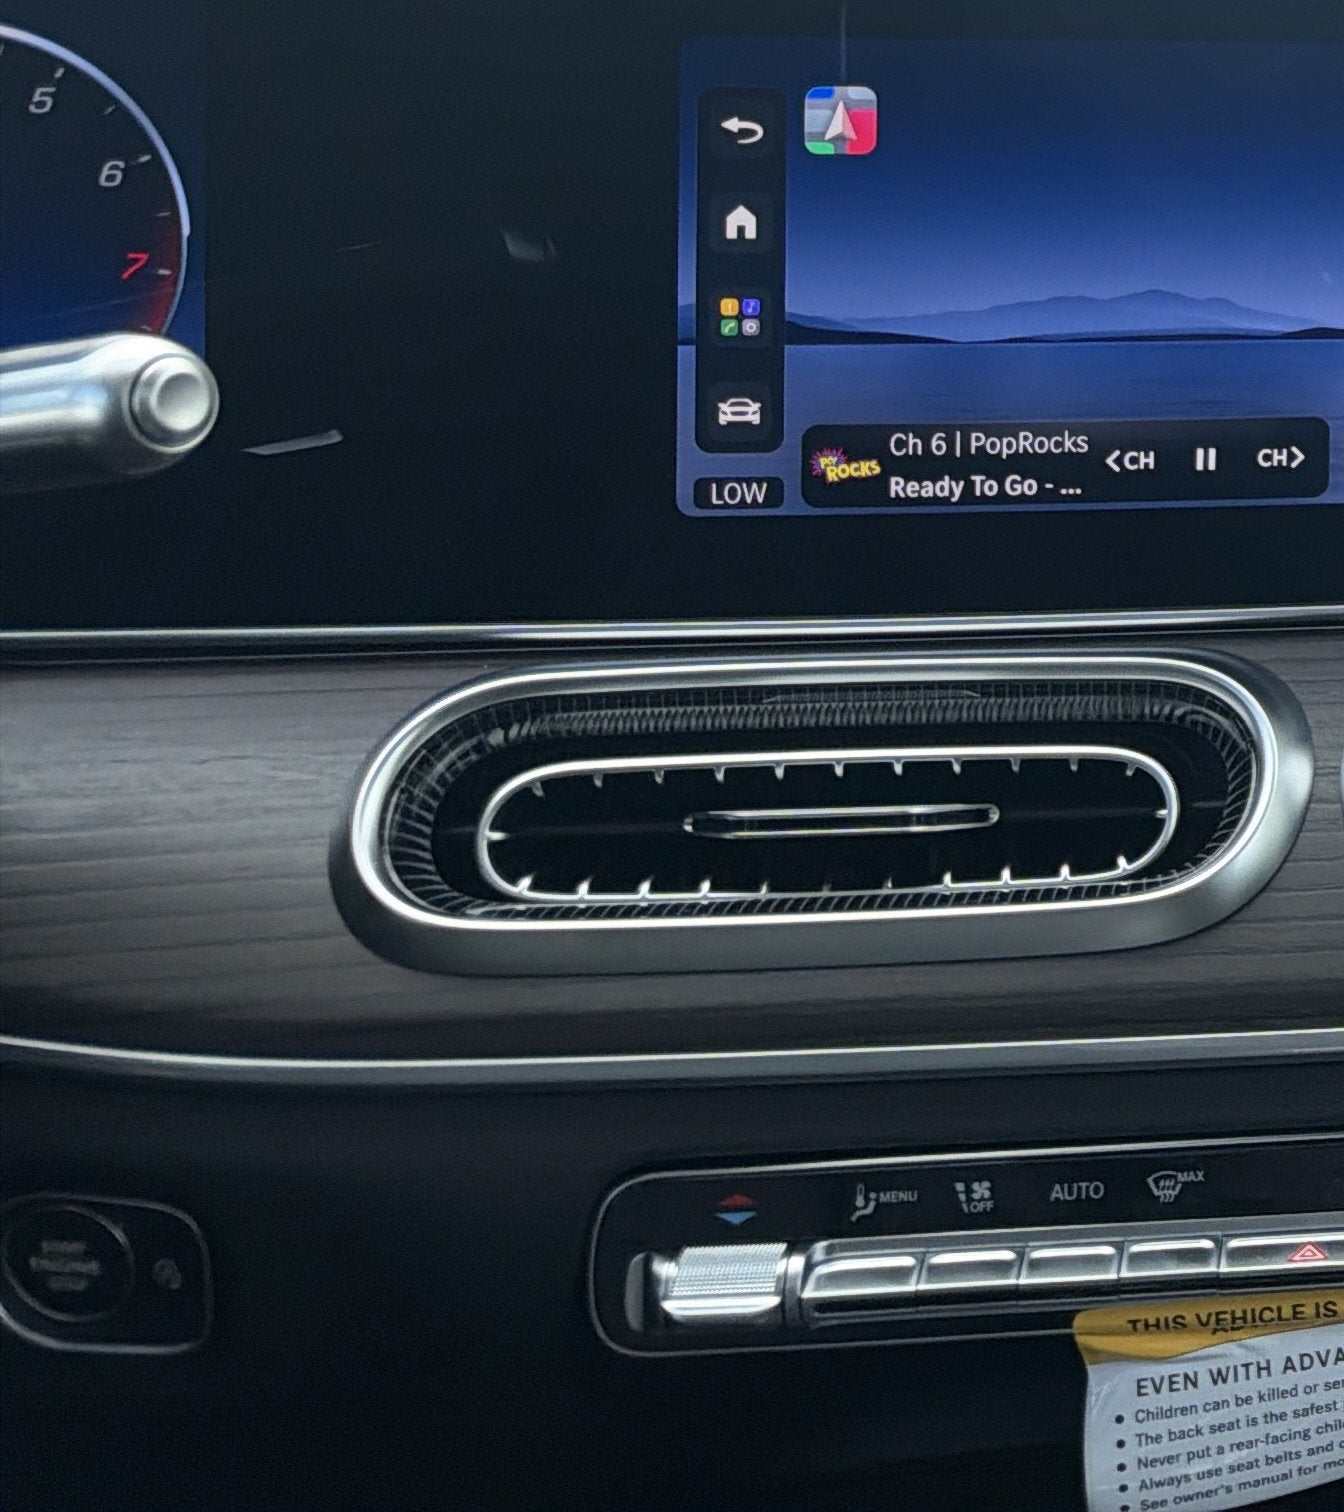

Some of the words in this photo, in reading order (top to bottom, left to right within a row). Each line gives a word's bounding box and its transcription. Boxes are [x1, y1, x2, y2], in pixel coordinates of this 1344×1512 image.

[28, 87, 57, 114] 5
[99, 160, 126, 187] 6
[120, 252, 149, 279] 7
[890, 432, 925, 457] Ch
[931, 433, 947, 456] 6
[970, 429, 1089, 460] PopRocks
[826, 459, 881, 482] ROCKS
[710, 483, 767, 505] LOW
[890, 475, 964, 502] Ready
[971, 474, 999, 498] To
[1004, 472, 1039, 497] Go
[1177, 1170, 1205, 1183] MAX
[878, 1190, 918, 1203] MENU
[1049, 1181, 1105, 1203] AUTO
[970, 1200, 995, 1213] OFF
[1127, 1314, 1188, 1333] THIS
[1195, 1303, 1306, 1328] VEHICLE
[1315, 1298, 1338, 1319] IS
[1136, 1370, 1199, 1397] EVEN
[1209, 1359, 1272, 1386] WITH
[1135, 1401, 1199, 1424] Children
[1202, 1398, 1230, 1414] can
[1235, 1392, 1254, 1407] be
[1258, 1385, 1299, 1404] killed
[1303, 1383, 1319, 1396] or
[1135, 1431, 1163, 1448] The
[1168, 1424, 1204, 1442] back
[1208, 1417, 1241, 1435] seat
[1246, 1414, 1259, 1428] is
[1263, 1407, 1289, 1426] the
[1292, 1399, 1339, 1419] safest
[1137, 1452, 1182, 1471] Never
[1186, 1445, 1212, 1465] put
[1216, 1444, 1226, 1457] a
[1229, 1426, 1312, 1454] rear-facing
[1138, 1470, 1191, 1492] Always
[1196, 1467, 1223, 1481] use
[1227, 1458, 1261, 1476] seat
[1264, 1448, 1302, 1467] belts
[1306, 1441, 1335, 1458] and
[1140, 1498, 1169, 1512] See
[1173, 1483, 1234, 1506] owner's
[1238, 1469, 1294, 1492] manual
[1297, 1463, 1318, 1478] for
